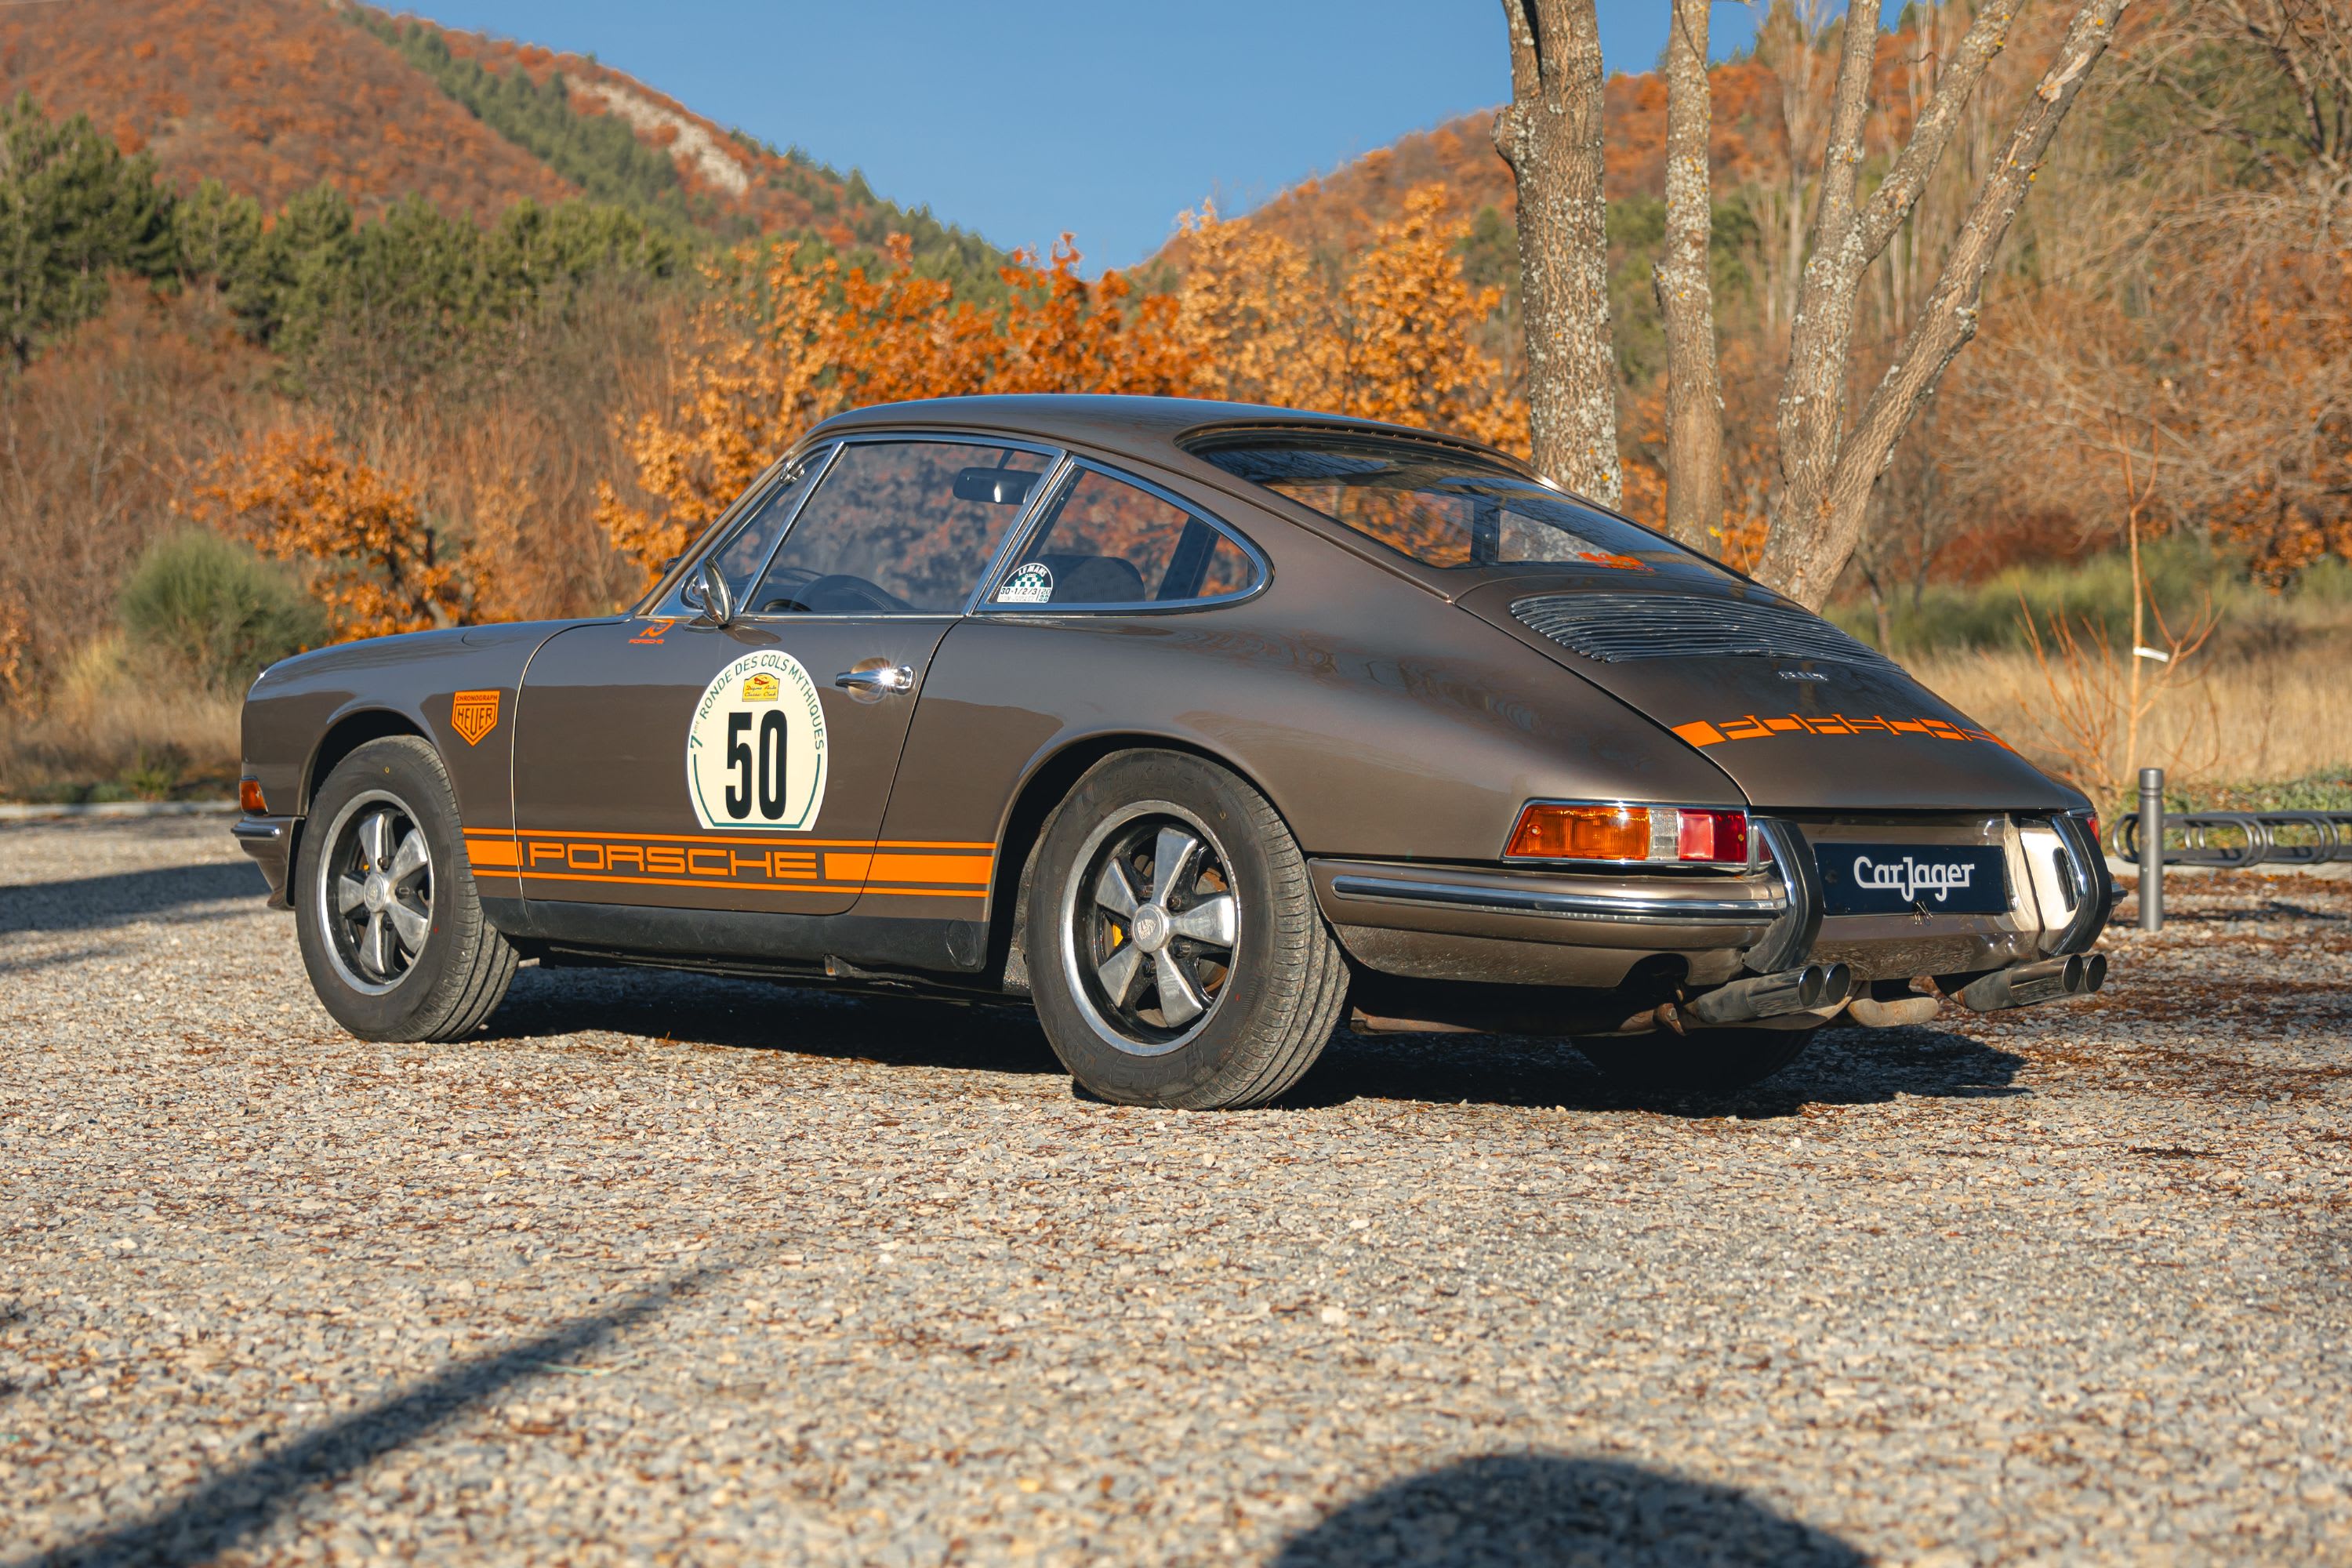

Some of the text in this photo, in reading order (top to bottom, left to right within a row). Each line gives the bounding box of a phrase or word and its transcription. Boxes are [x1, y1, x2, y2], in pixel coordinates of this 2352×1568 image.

[1018, 566, 1027, 577] LE
[1027, 564, 1047, 577] MANS
[457, 708, 492, 736] HEUER
[699, 670, 732, 720] RONDE
[735, 655, 758, 676] DES
[761, 655, 789, 671] COLS
[788, 664, 824, 750] MYTHIQUES
[725, 710, 788, 820] 50
[528, 841, 818, 880] PORSCHE
[1853, 855, 1975, 902] CarJager
